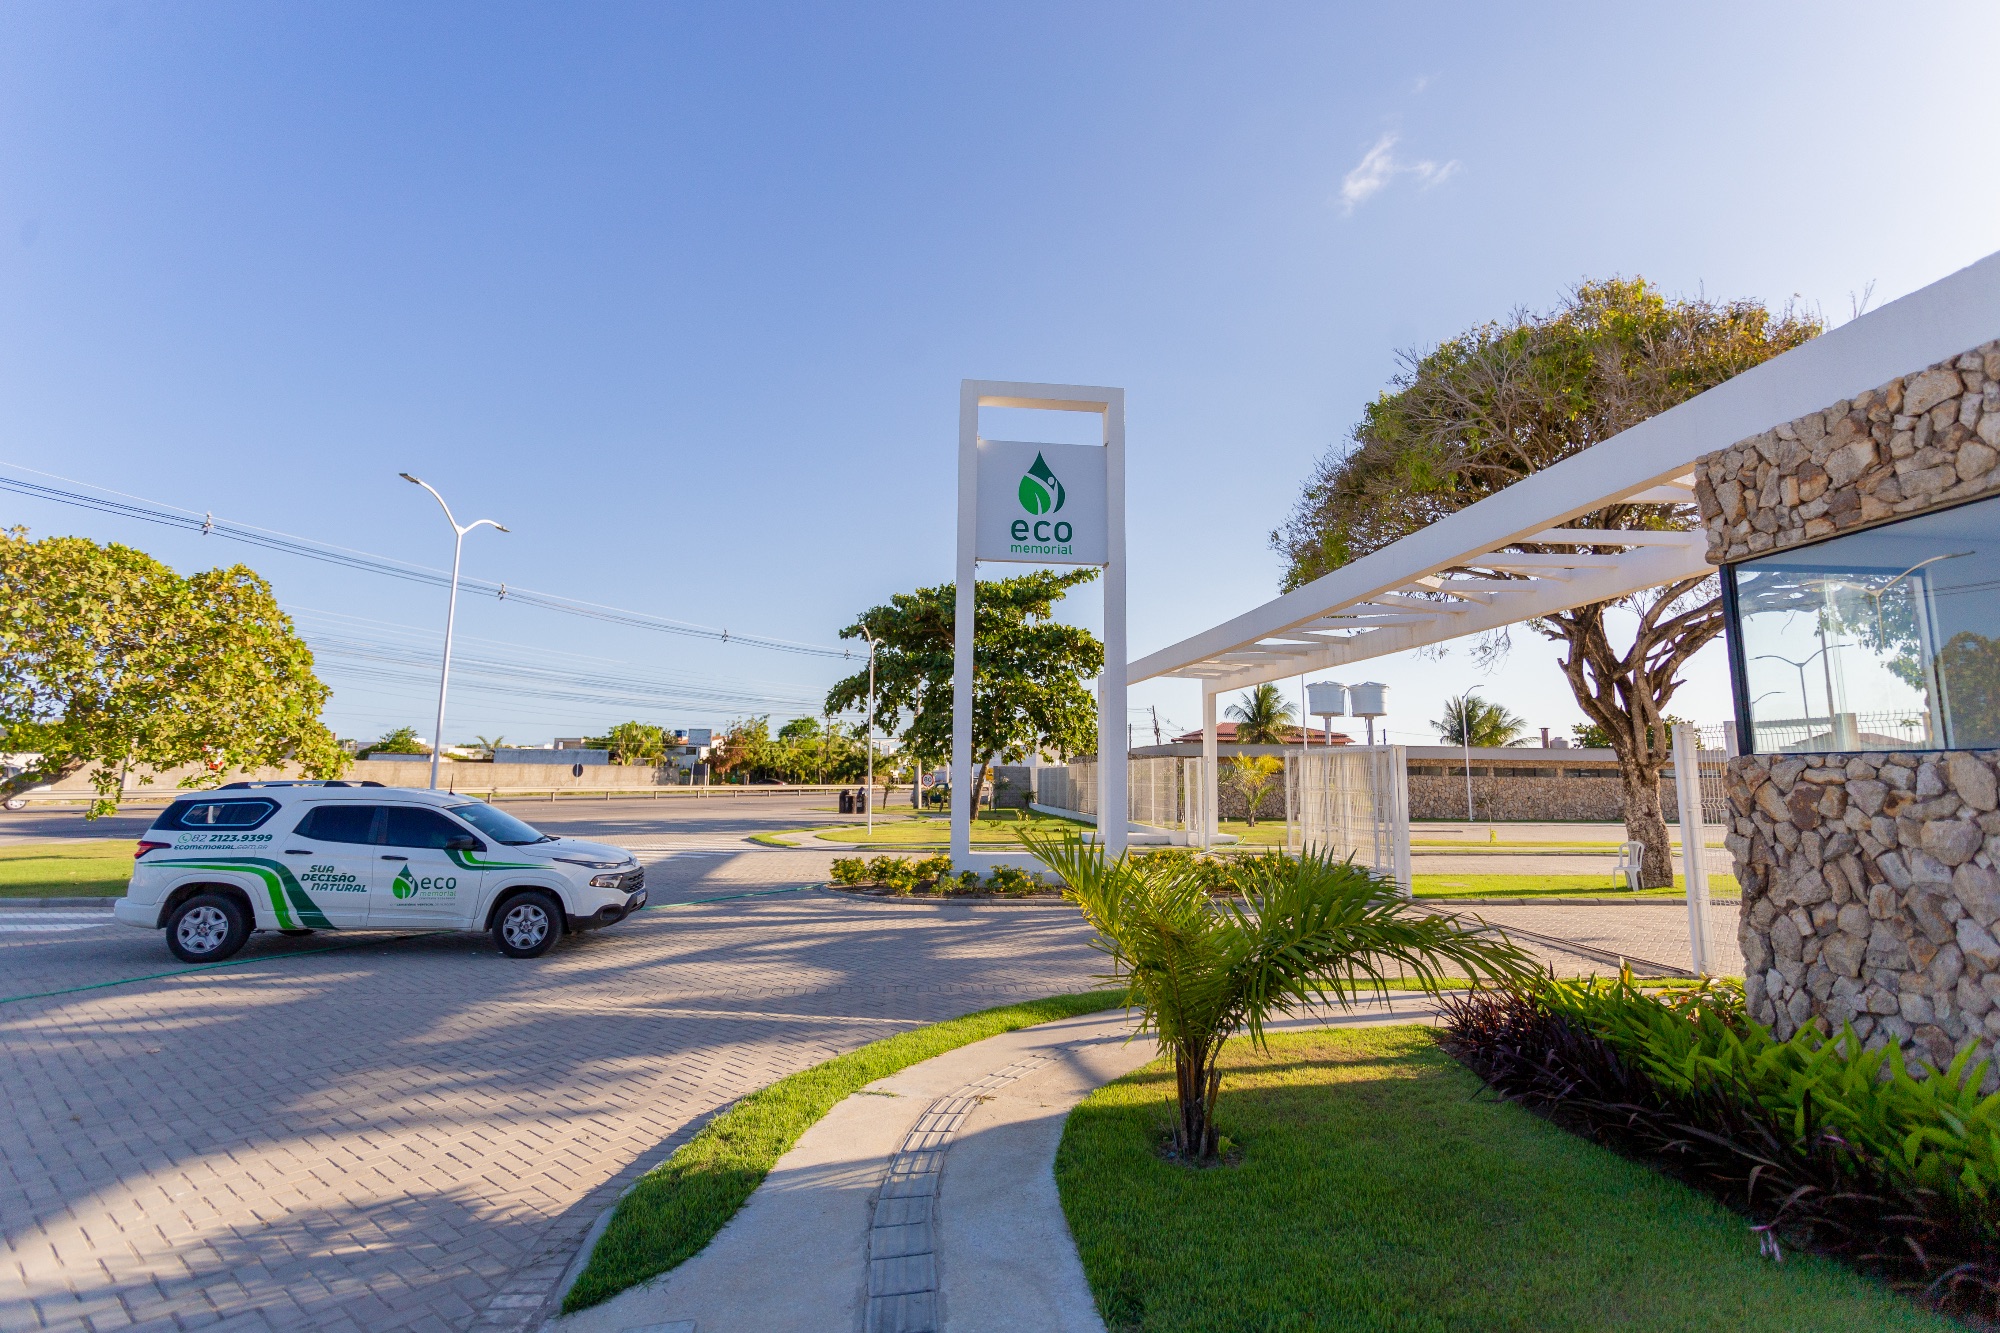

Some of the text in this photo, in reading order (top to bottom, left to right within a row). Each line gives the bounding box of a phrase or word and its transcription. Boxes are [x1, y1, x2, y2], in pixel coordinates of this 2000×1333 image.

[1010, 519, 1073, 543] eco
[1010, 544, 1073, 555] memorial
[191, 834, 273, 842] 82 2123.9399
[309, 864, 335, 873] SUA
[300, 872, 356, 883] DECISÃO
[310, 883, 367, 893] NATURAL
[420, 877, 457, 890] eco
